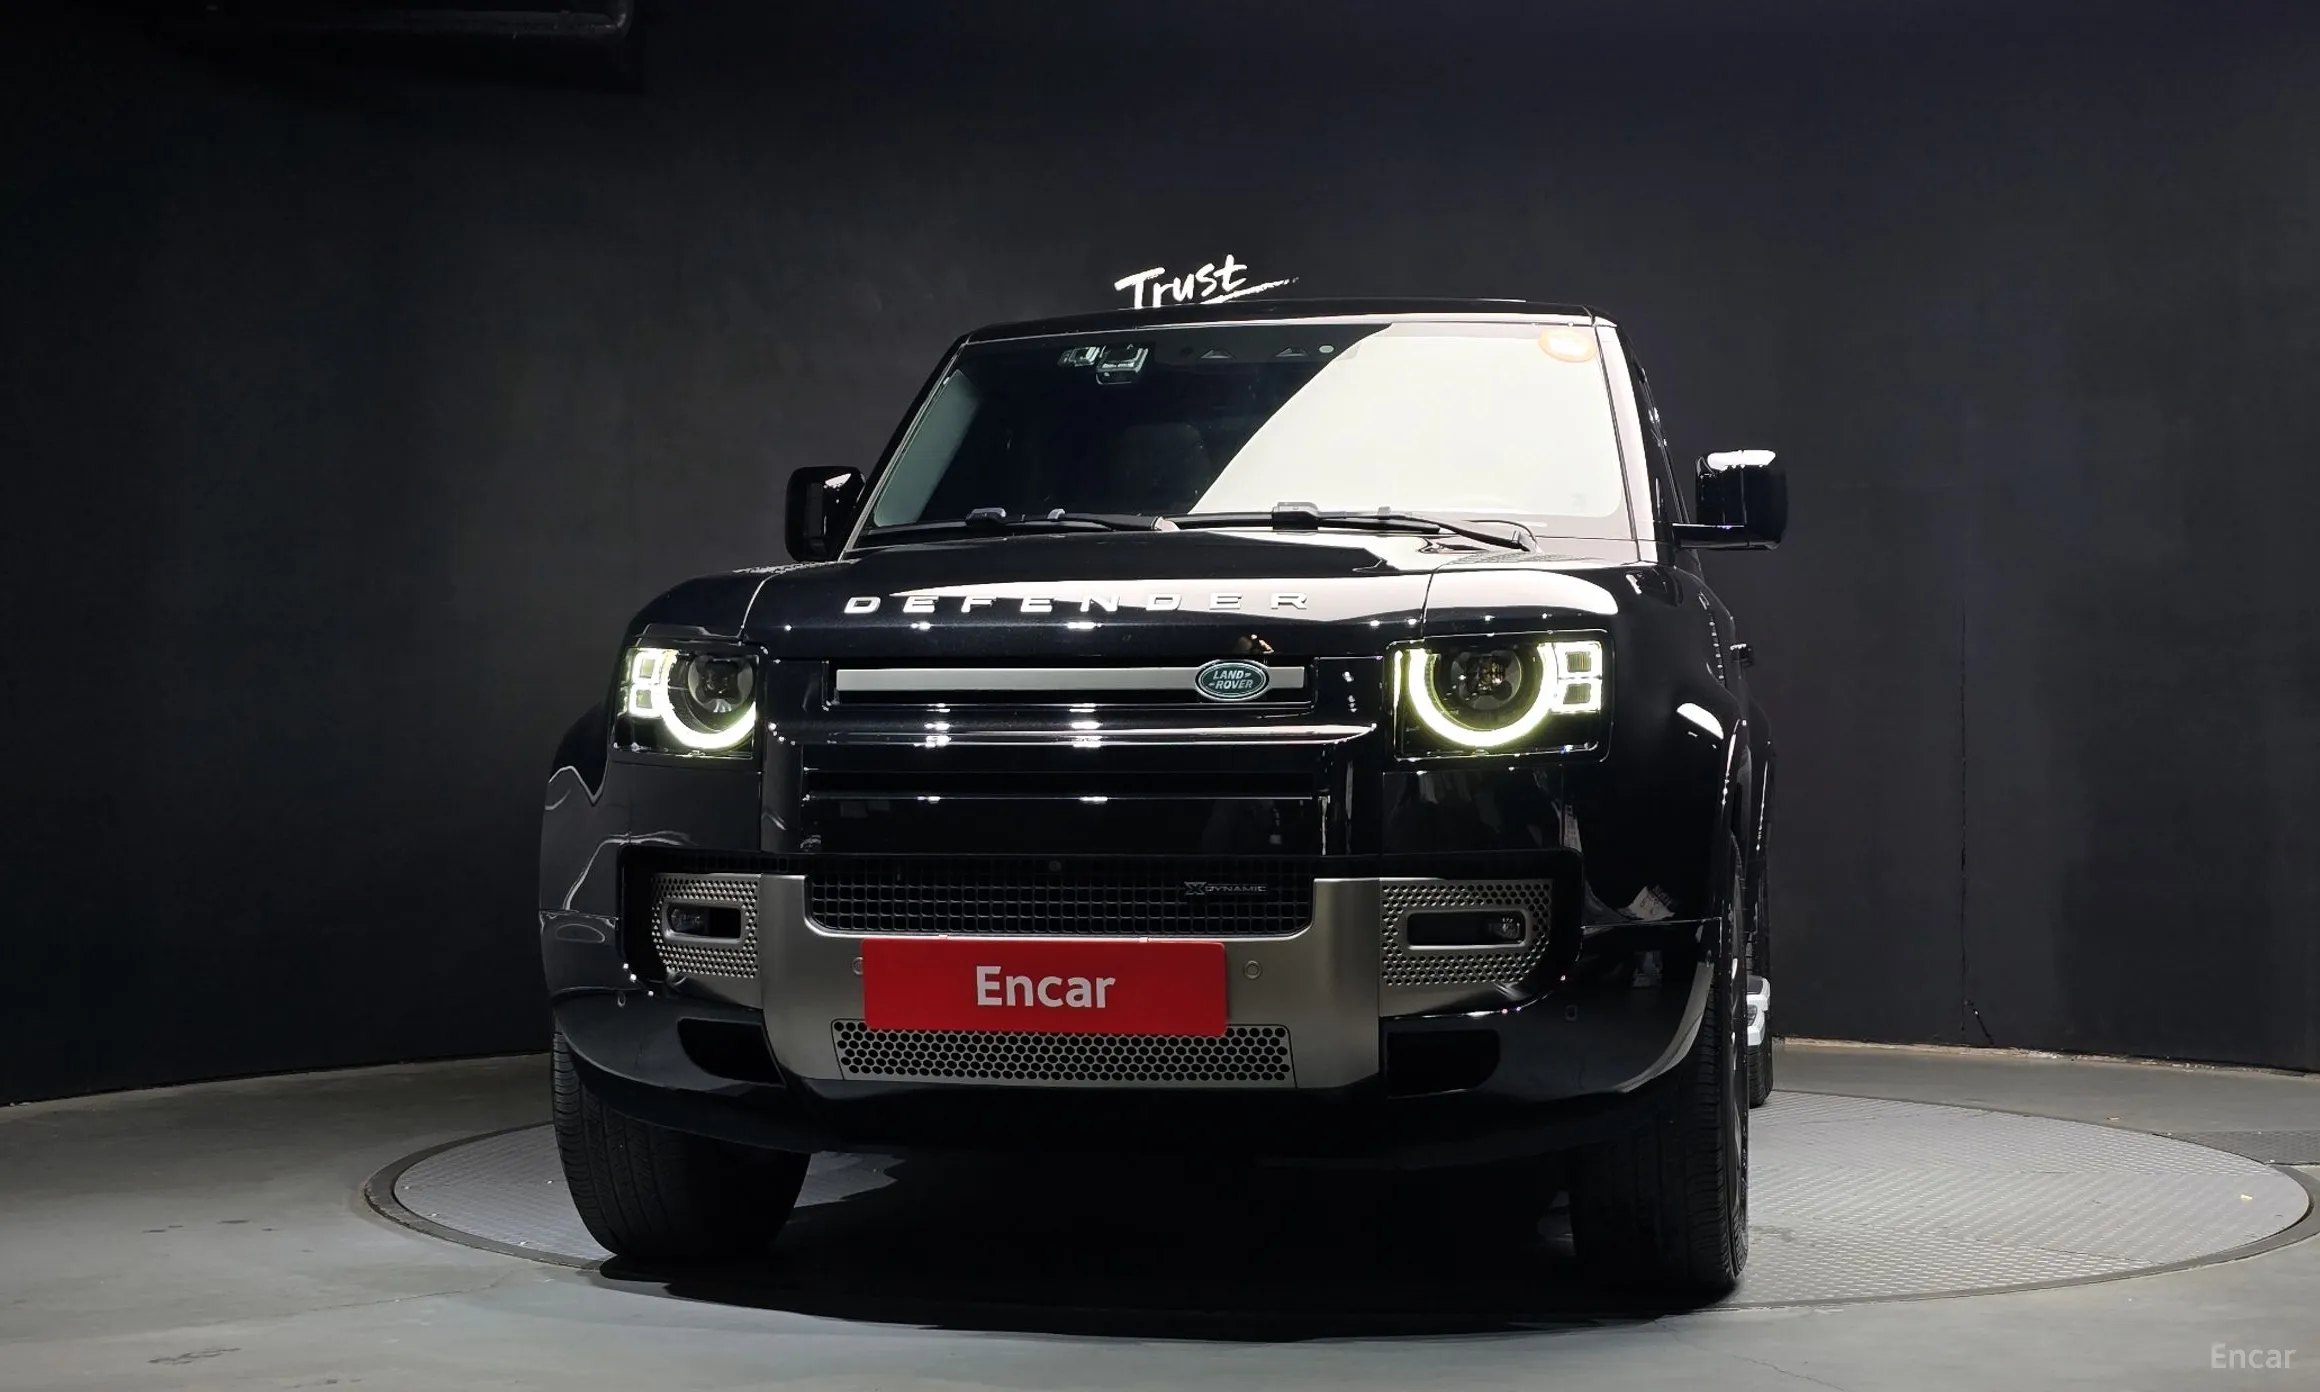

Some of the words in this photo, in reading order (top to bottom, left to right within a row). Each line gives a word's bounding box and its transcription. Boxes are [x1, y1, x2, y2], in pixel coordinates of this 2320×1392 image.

[1114, 254, 1248, 310] Trust
[843, 592, 1308, 614] DEFENDER
[976, 965, 1116, 1009] Encar
